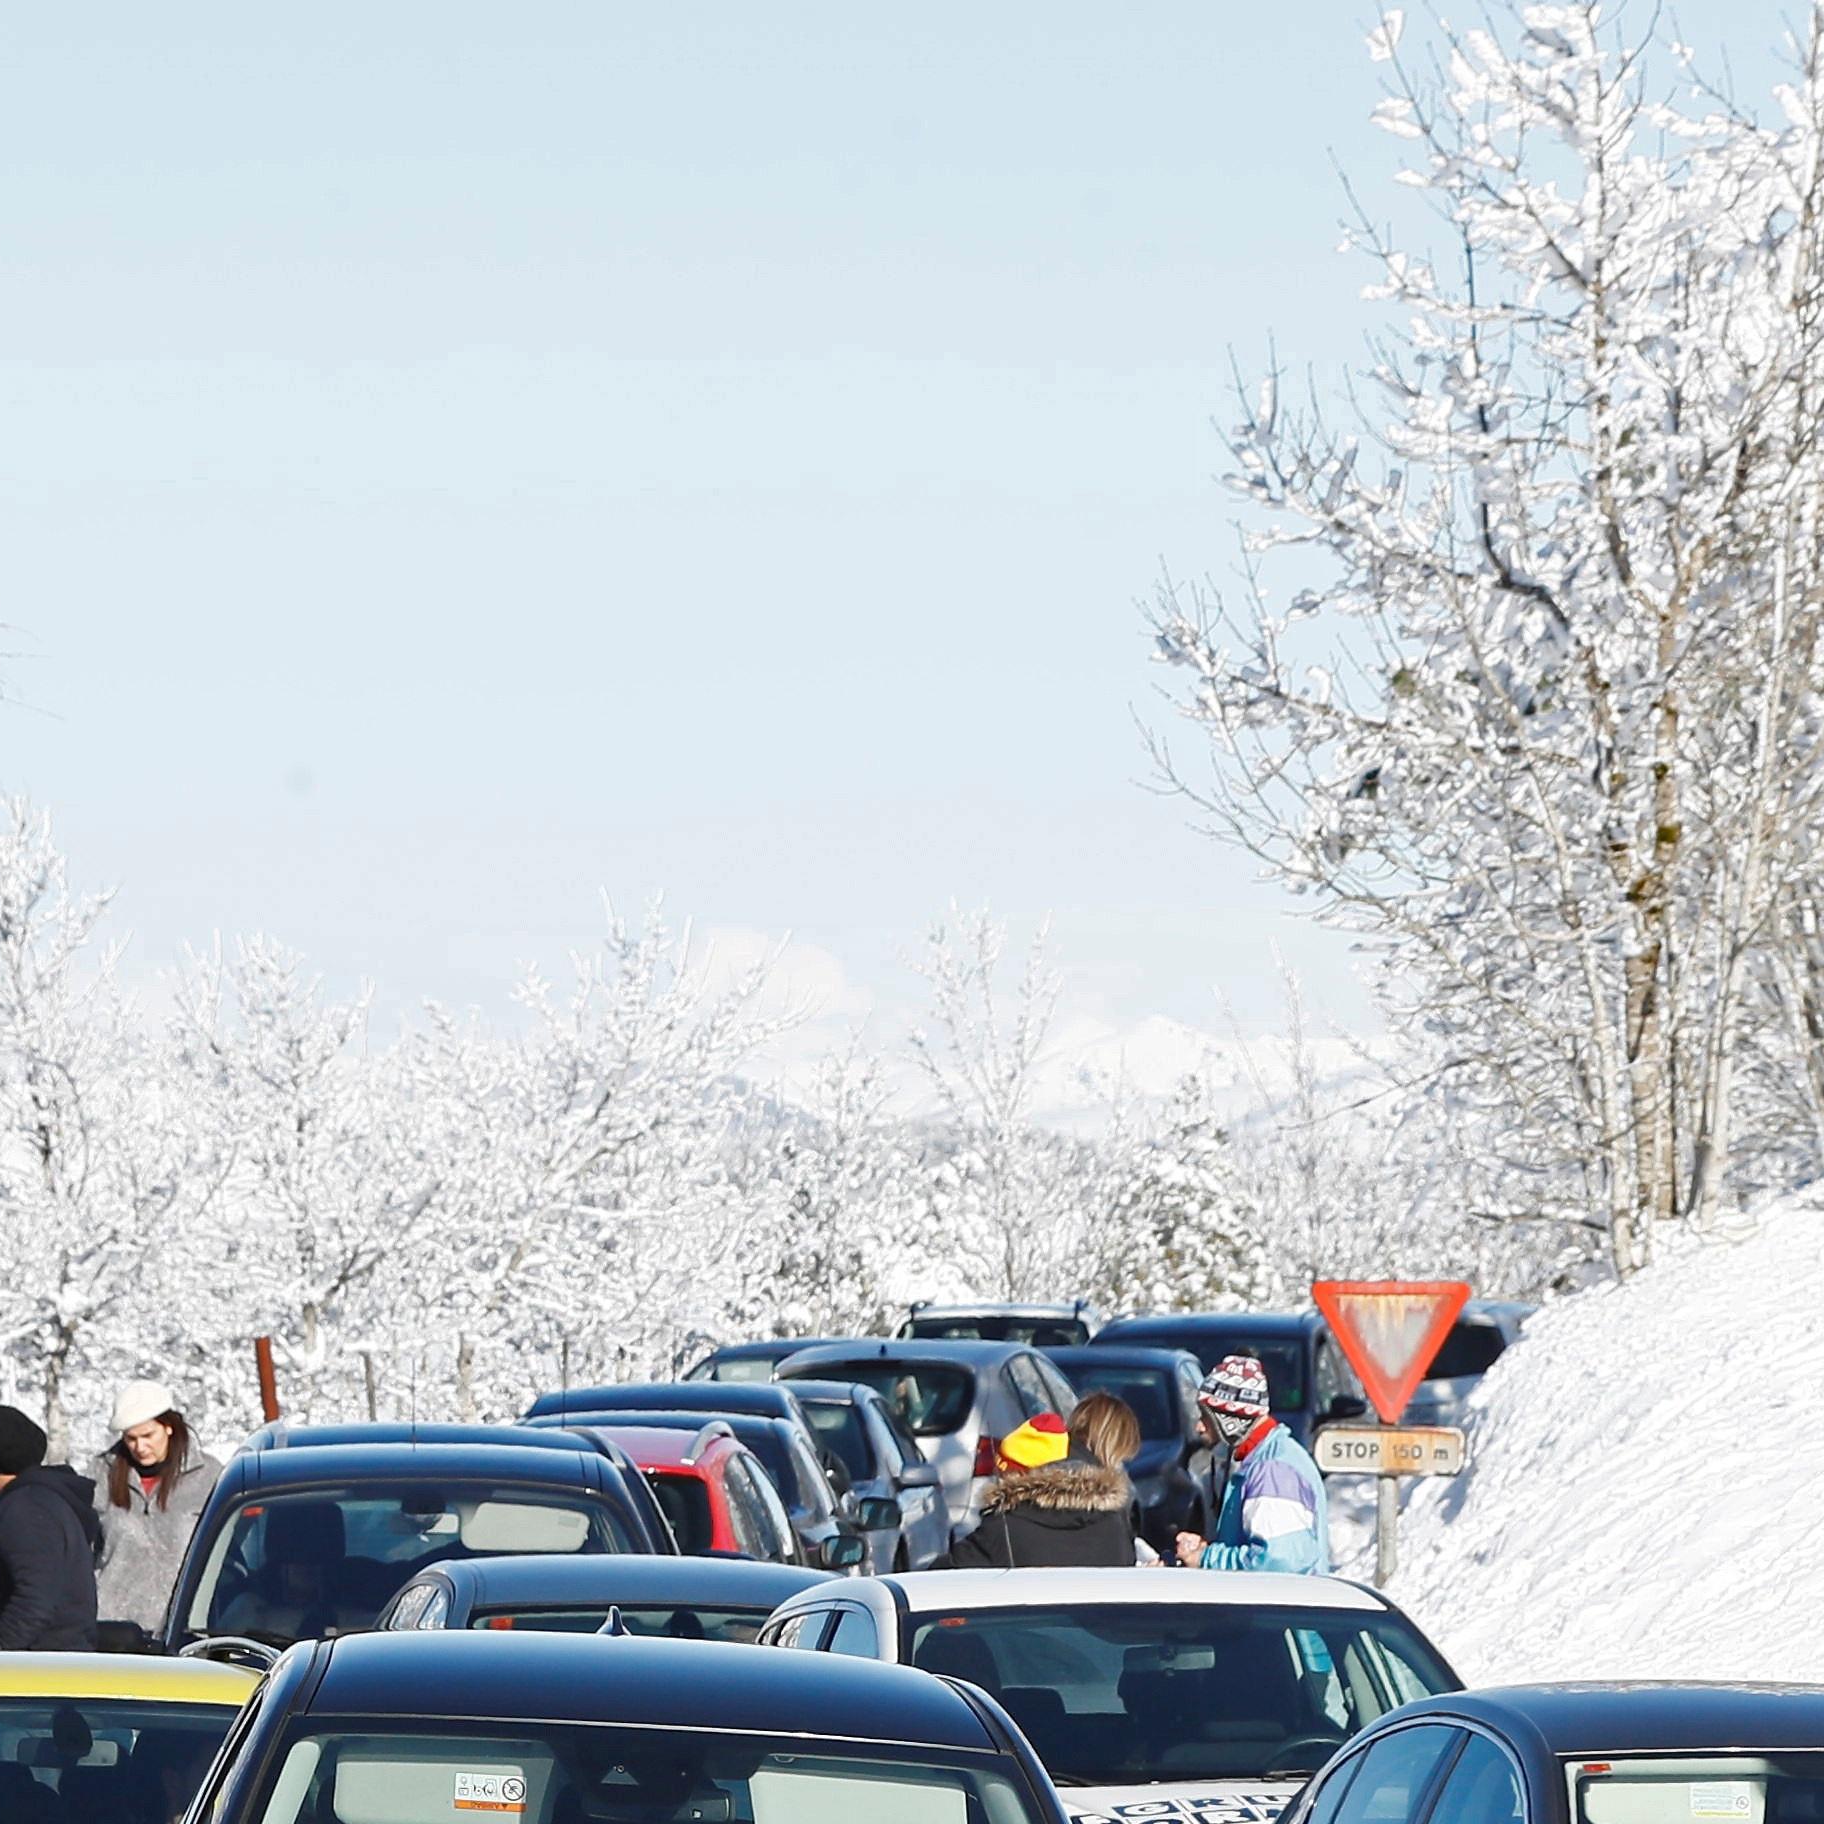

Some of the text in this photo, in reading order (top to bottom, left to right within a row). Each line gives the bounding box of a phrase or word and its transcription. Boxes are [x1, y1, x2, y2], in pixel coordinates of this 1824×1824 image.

[1331, 1442, 1449, 1460] STOP 150 m
